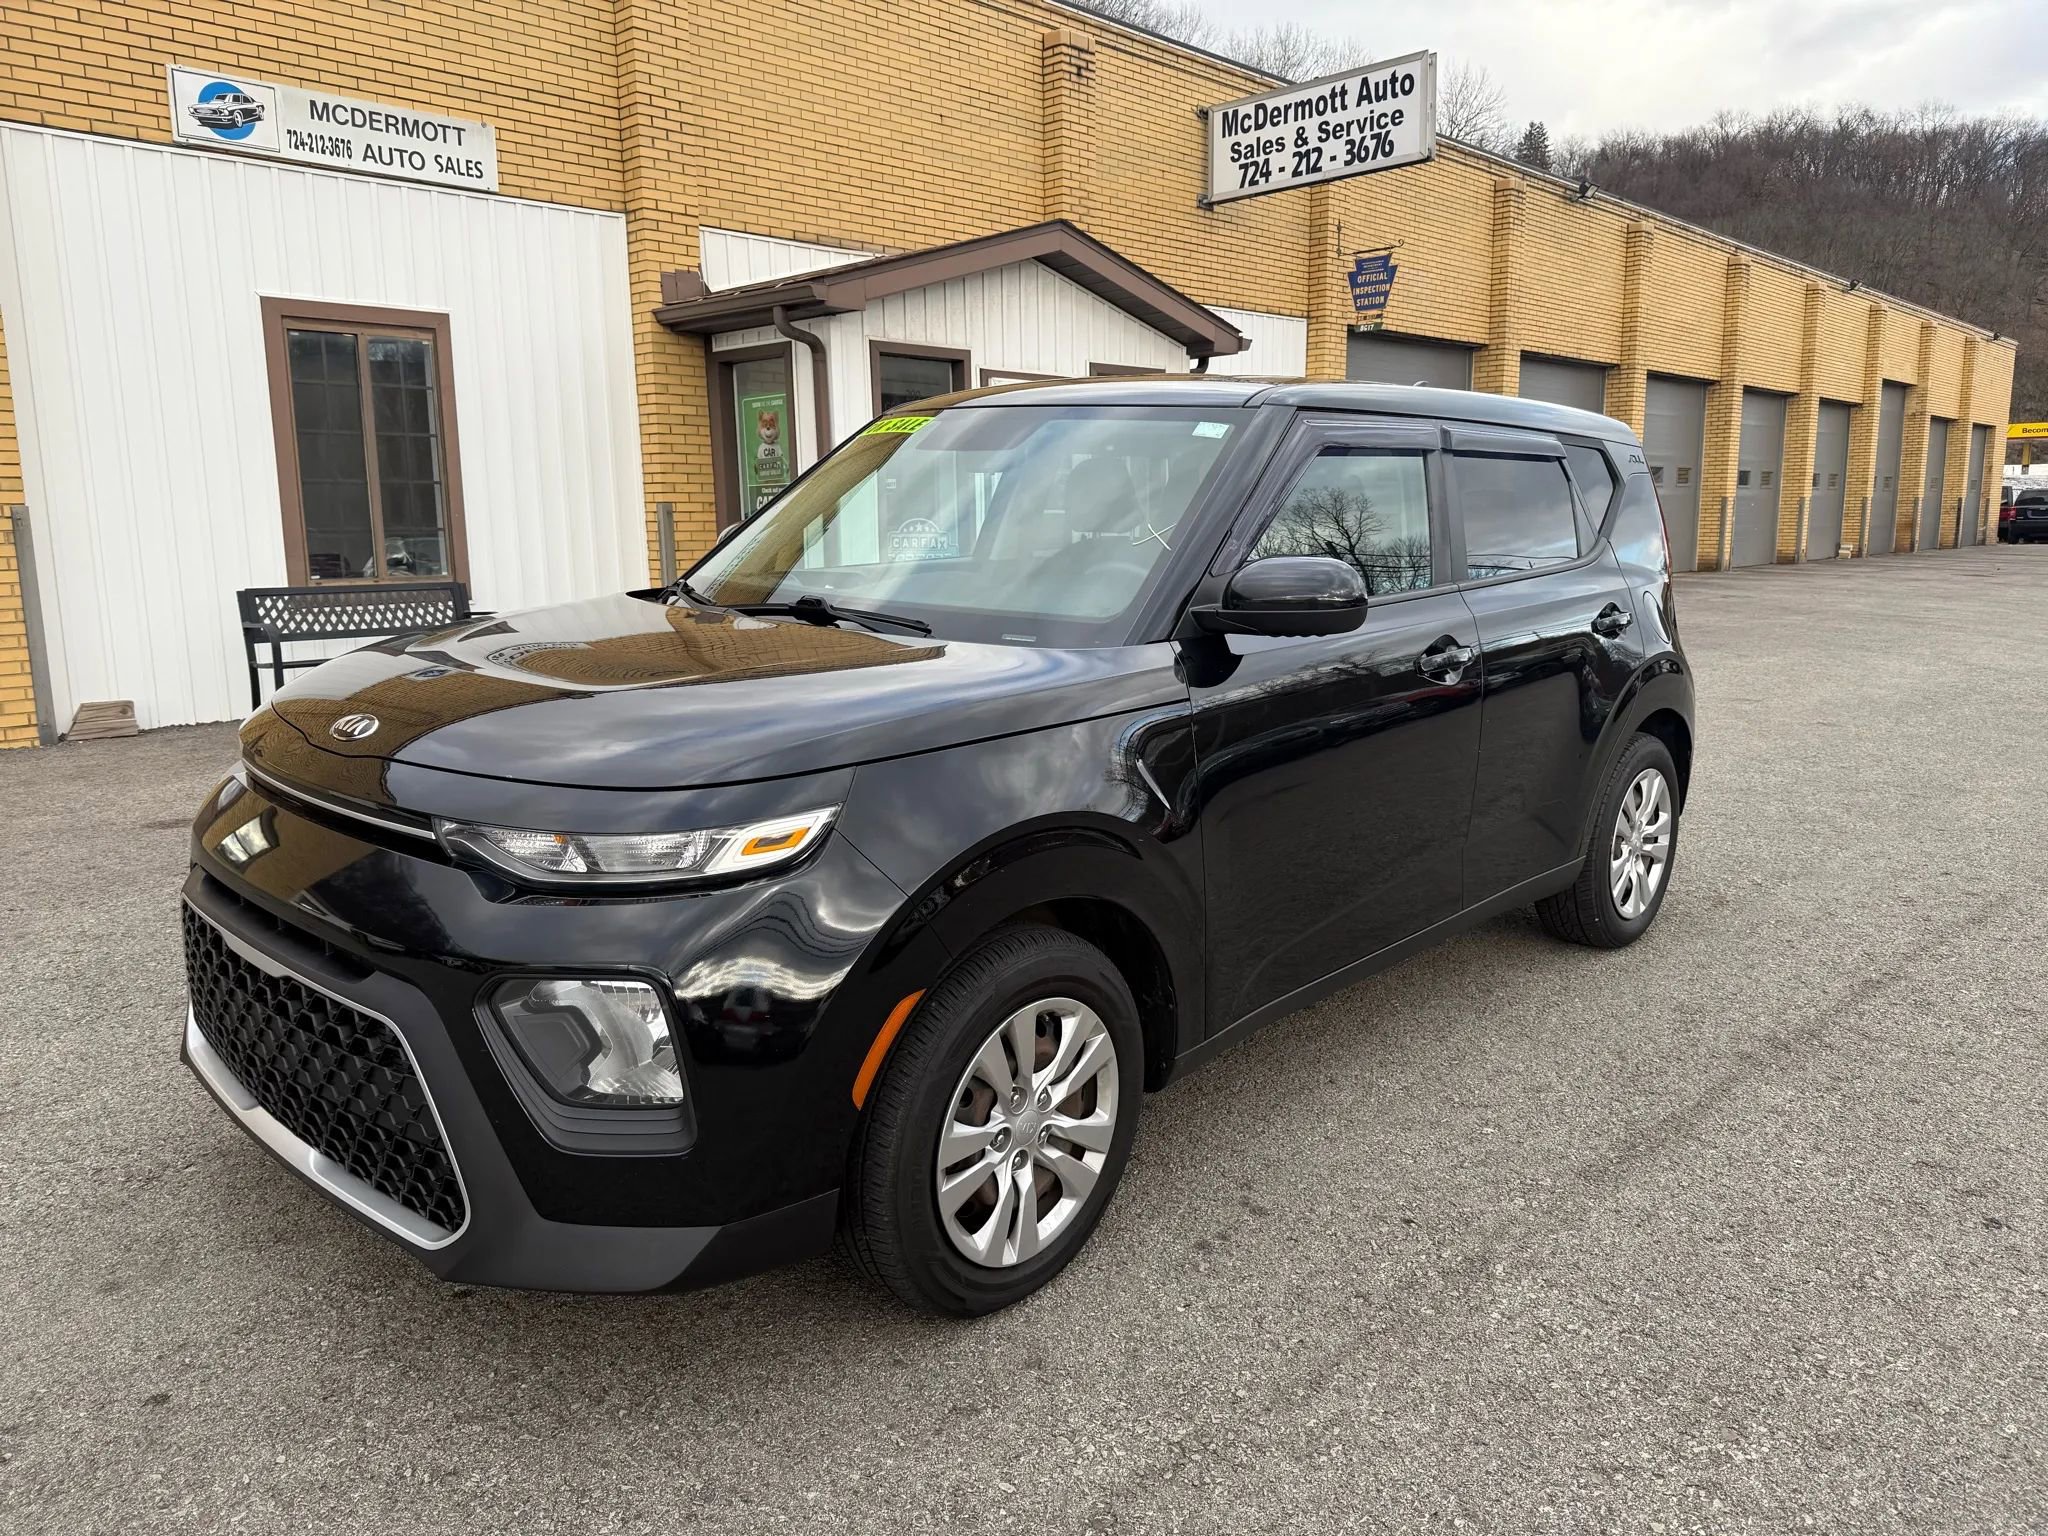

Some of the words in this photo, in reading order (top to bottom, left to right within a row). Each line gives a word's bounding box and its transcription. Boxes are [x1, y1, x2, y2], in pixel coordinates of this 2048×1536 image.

[1222, 83, 1348, 138] McDermott
[1355, 69, 1415, 108] Auto
[309, 99, 466, 147] MCDERMOTT
[1230, 136, 1286, 163] Sales
[1293, 126, 1309, 149] &
[1317, 108, 1404, 143] Service
[286, 128, 353, 160] 724-212-3676
[361, 143, 426, 171] AUTO
[434, 154, 484, 179] SALES
[1238, 157, 1272, 189] 724
[1291, 146, 1323, 178] 212
[1343, 130, 1395, 167] 3676
[1353, 284, 1391, 295] INSPECTION
[1357, 272, 1388, 284] OFFICIAL
[1356, 296, 1385, 307] STATION
[763, 447, 776, 457] CAR
[893, 536, 948, 550] CARFAX
[334, 716, 370, 736] KIA
